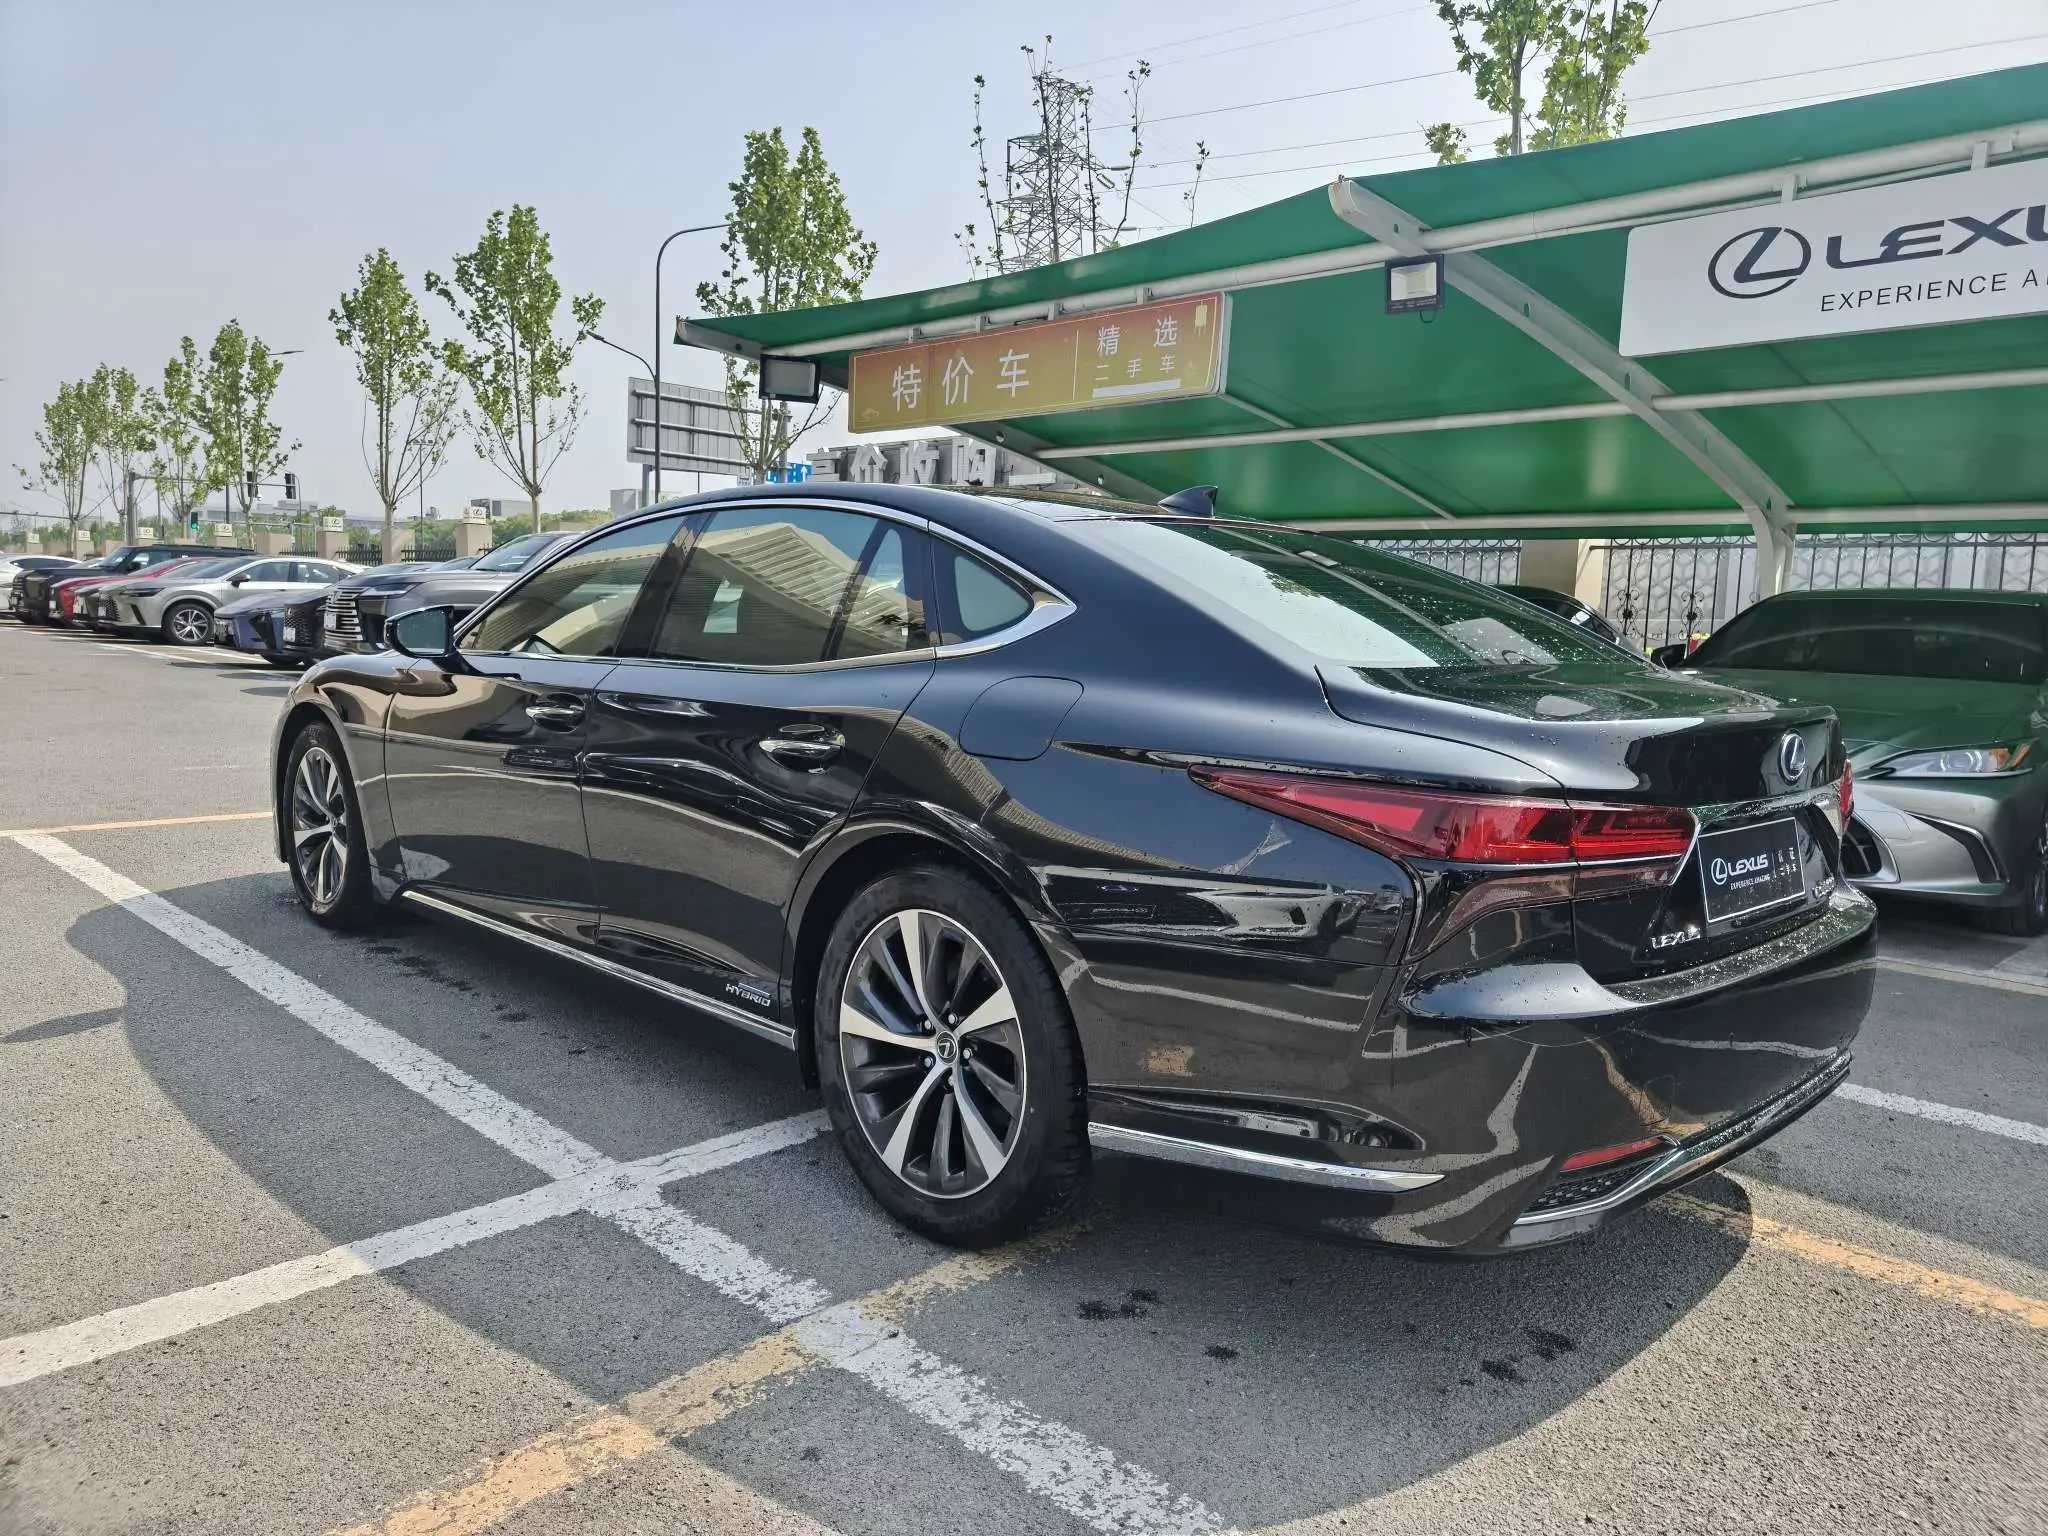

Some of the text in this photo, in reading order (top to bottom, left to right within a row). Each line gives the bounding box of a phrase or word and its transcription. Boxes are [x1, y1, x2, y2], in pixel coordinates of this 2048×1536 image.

[1820, 272, 2008, 312] EXPERIENCE
[1096, 315, 1178, 357] 精选
[892, 348, 1030, 412] 特价车
[1094, 353, 1177, 381] 二手车
[1728, 853, 1769, 876] LEXUS
[725, 983, 771, 1007] HYBRID
